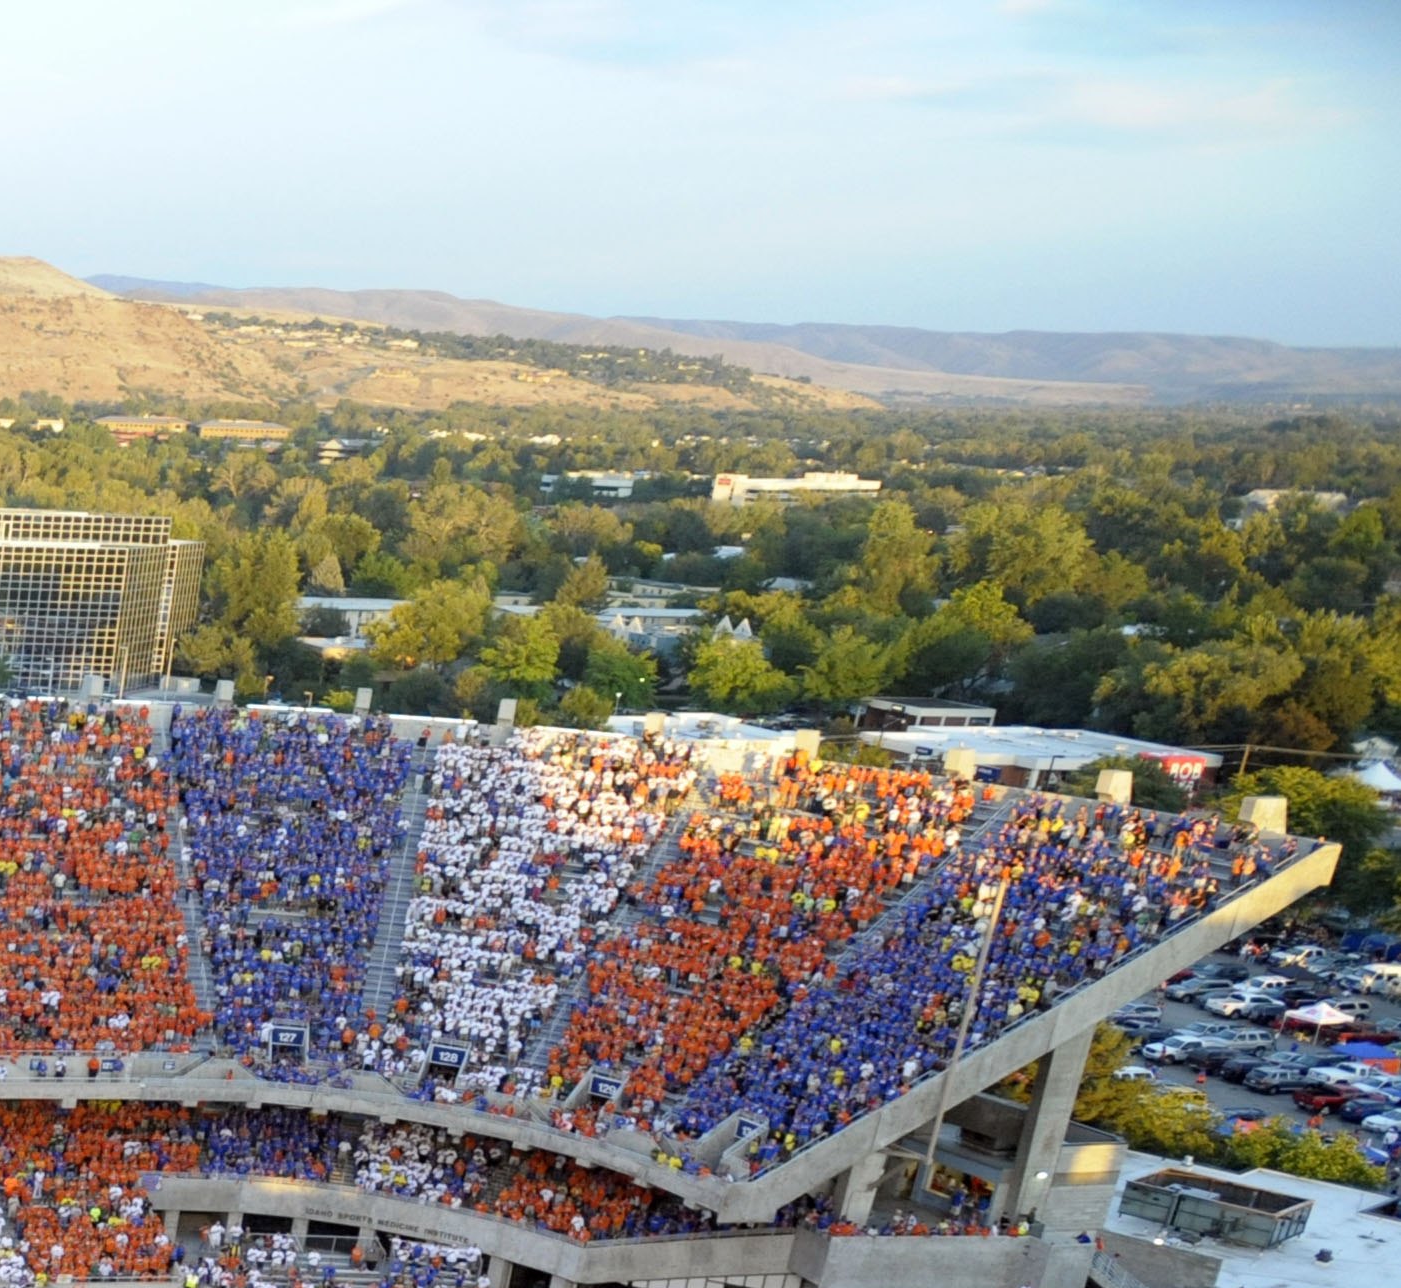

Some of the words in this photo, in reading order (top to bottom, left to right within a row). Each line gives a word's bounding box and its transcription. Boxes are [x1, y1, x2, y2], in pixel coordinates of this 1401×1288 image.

[278, 1032, 295, 1042] 127
[439, 1051, 458, 1063] 128
[599, 1081, 616, 1097] 129
[305, 1208, 333, 1217] IDAHO
[338, 1212, 373, 1224] SPORTS
[378, 1219, 419, 1233] MEDICINE
[424, 1228, 469, 1244] INSTITUTE
